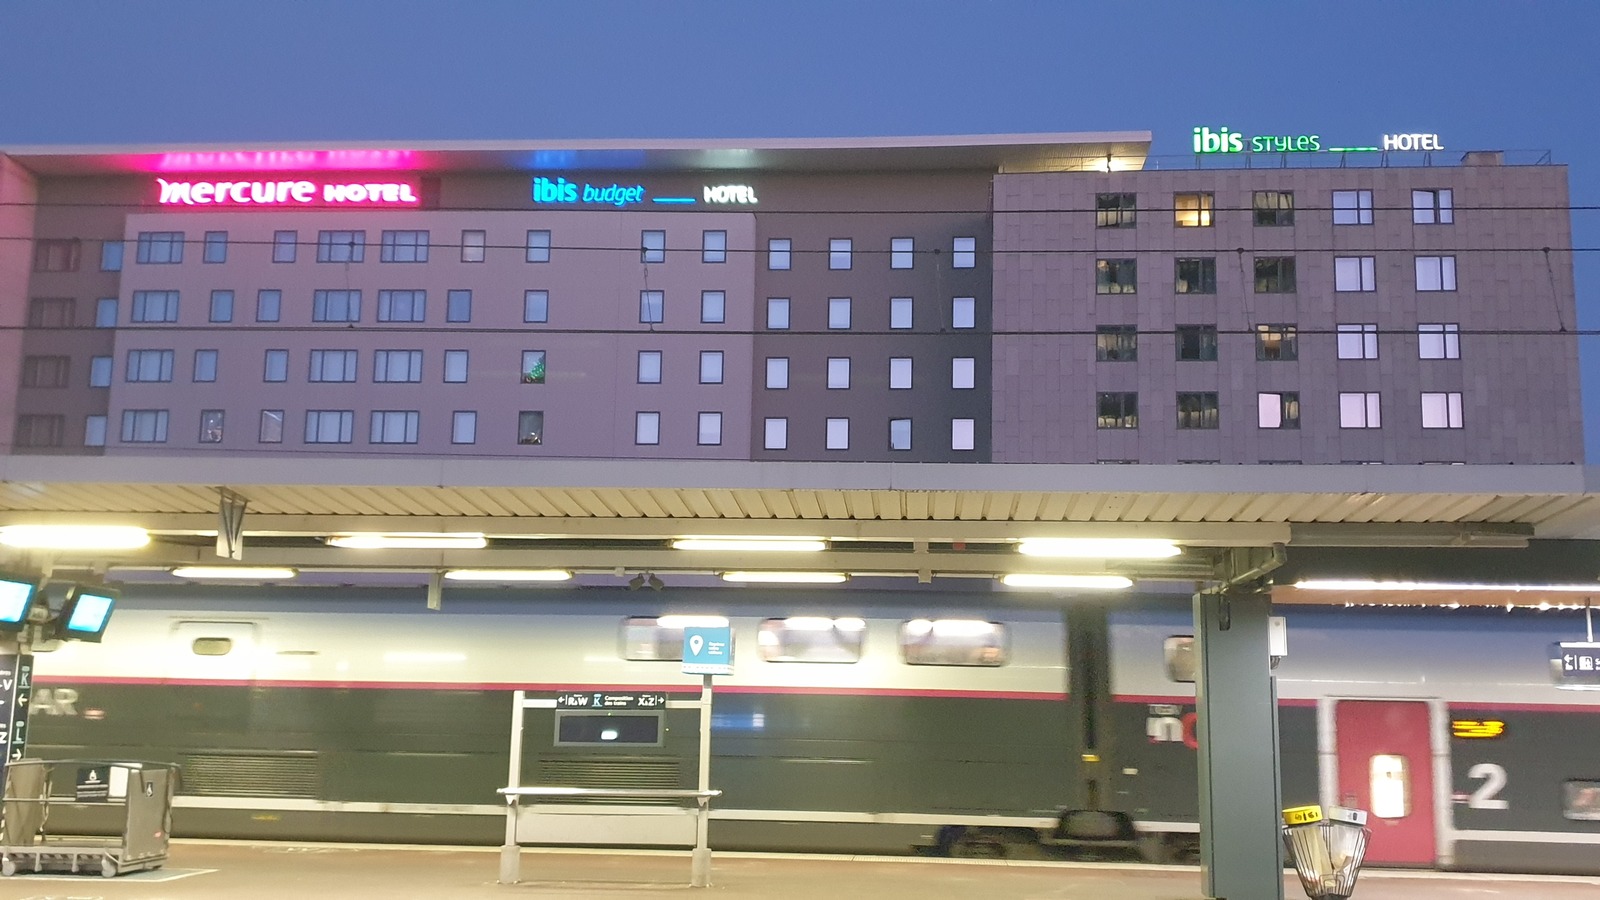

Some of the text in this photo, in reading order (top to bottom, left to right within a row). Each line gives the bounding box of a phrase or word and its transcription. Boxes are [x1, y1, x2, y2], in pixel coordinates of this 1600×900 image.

[1193, 126, 1244, 153] ibis
[1382, 133, 1445, 151] HOTEL
[156, 178, 418, 205] mercure HOTEL
[532, 177, 759, 207] ibis budget HOTEL
[21, 672, 29, 687] K
[1467, 763, 1510, 810] 2
